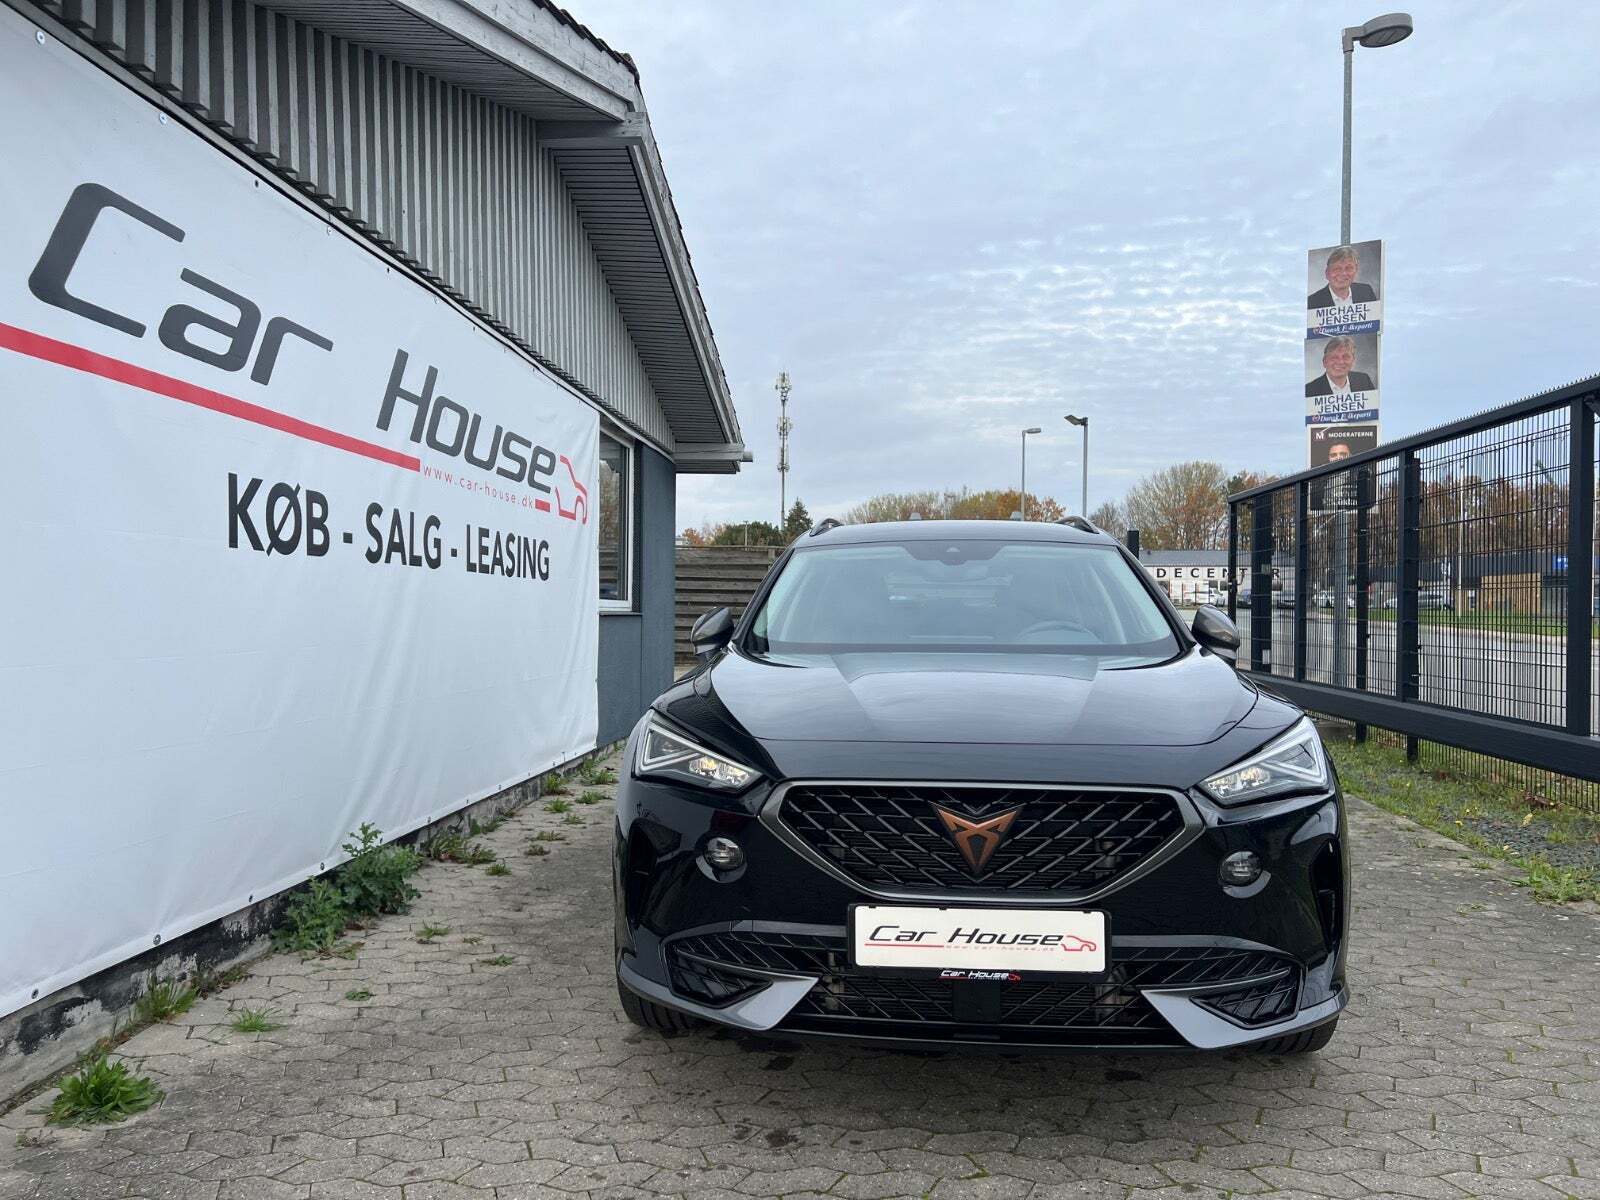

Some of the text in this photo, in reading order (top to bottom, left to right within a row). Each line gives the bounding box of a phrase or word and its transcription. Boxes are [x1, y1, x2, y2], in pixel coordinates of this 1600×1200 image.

[1316, 303, 1370, 318] MICHAEL
[1319, 312, 1367, 326] JENSEN
[28, 182, 556, 494] Car House
[1314, 392, 1368, 406] MICHAEL
[1317, 401, 1365, 414] JENSEN
[423, 465, 533, 509] www.car-house.dk
[227, 472, 330, 557] KØB
[365, 501, 442, 570] SALG
[465, 526, 550, 581] LEASING
[1156, 568, 1280, 578] DECENTR
[869, 925, 1064, 946] Car House
[968, 970, 1009, 978] House
